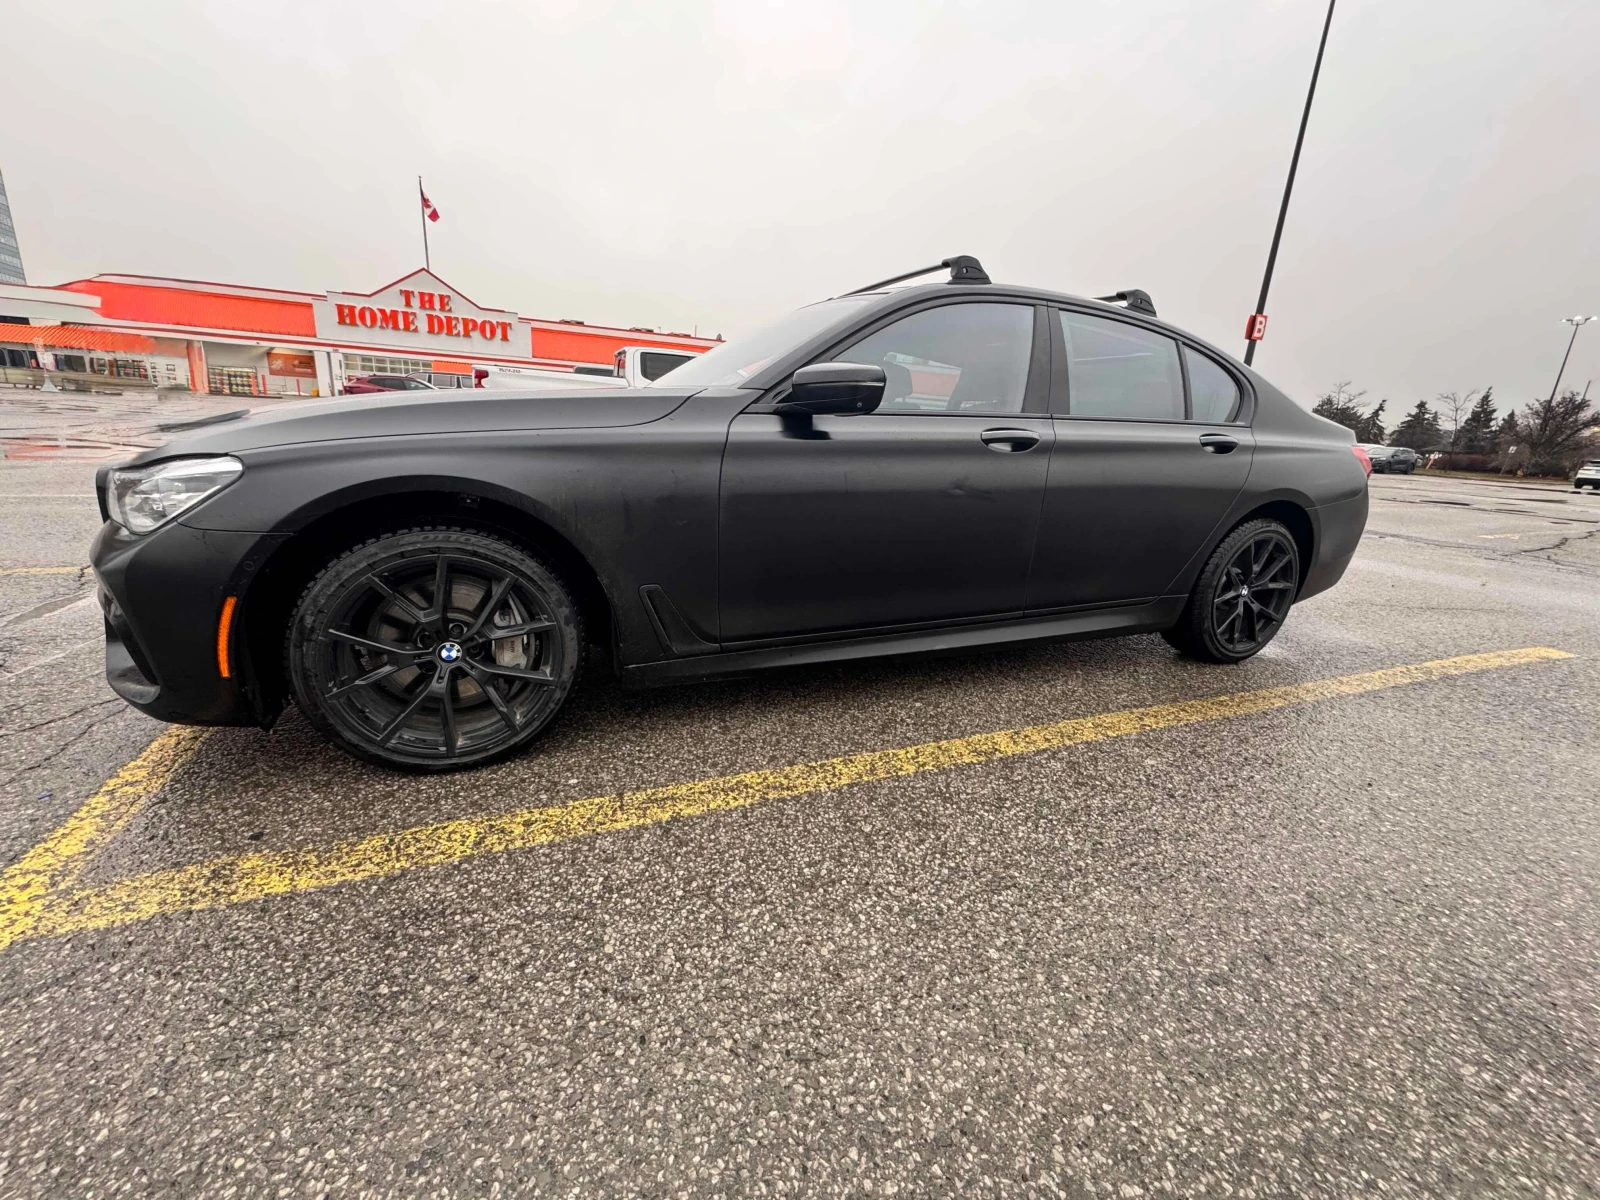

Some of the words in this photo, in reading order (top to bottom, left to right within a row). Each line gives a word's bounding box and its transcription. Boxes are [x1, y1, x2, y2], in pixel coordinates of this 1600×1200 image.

[400, 289, 452, 313] THE
[335, 303, 419, 333] HOME
[425, 313, 512, 341] DEPOT
[1254, 316, 1266, 338] B
